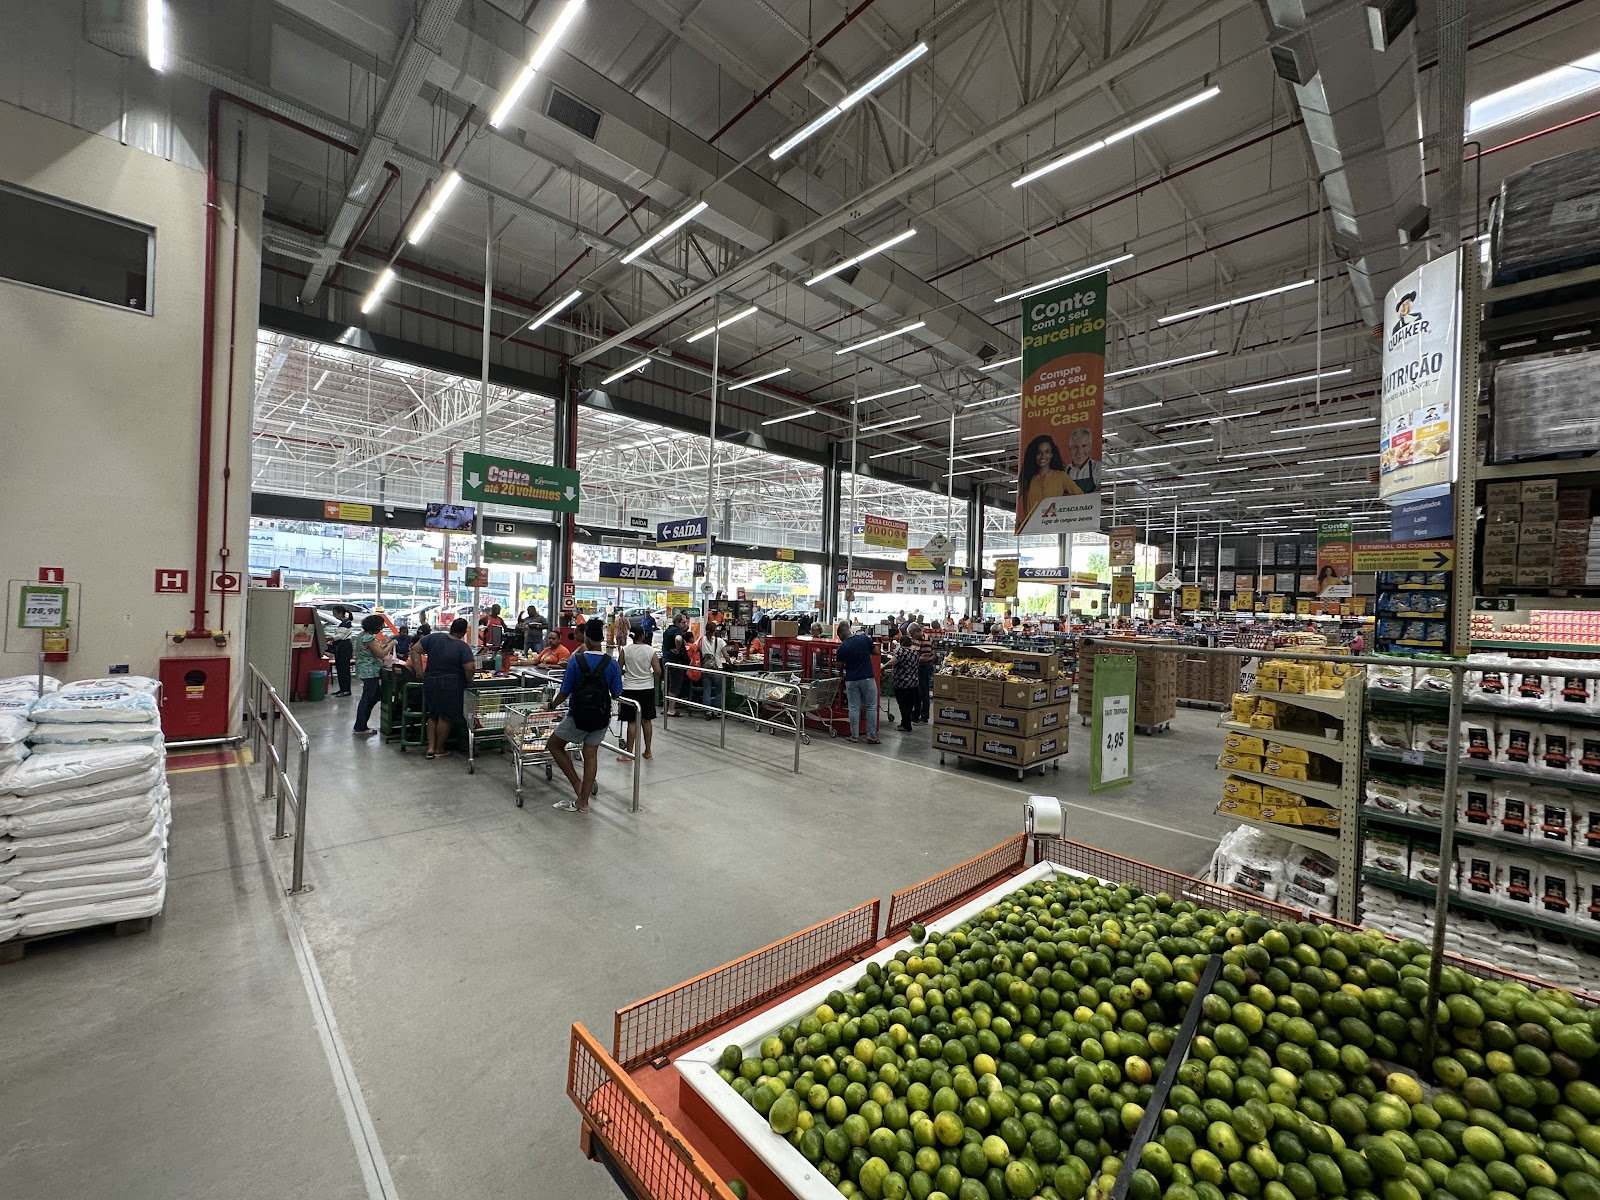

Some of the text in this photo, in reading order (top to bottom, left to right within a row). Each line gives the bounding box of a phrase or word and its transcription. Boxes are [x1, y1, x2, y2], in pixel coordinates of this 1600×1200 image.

[1030, 290, 1097, 321] Conte
[1031, 308, 1089, 331] com o seu
[1022, 317, 1106, 350] Parceirão
[1387, 320, 1430, 352] QUAKER
[1039, 365, 1082, 382] Compre
[1383, 352, 1443, 397] NUTRIÇÃO
[1033, 373, 1087, 393] para o seu
[1023, 382, 1098, 409] Negócio
[1027, 398, 1097, 418] ou para a sua
[1050, 410, 1089, 427] Casa
[486, 465, 531, 487] Caixa
[483, 483, 562, 501] até 20 volumes
[1402, 501, 1442, 514] Achocolatados
[631, 519, 648, 527] SAÍDA
[672, 520, 703, 539] SAÍDA
[867, 517, 907, 530] CAIXA EXCLUSIVO
[1041, 518, 1053, 526] Lugar
[1321, 522, 1349, 530] Conte
[619, 563, 659, 580] SAÍDA
[694, 564, 704, 574] 10
[1033, 568, 1063, 578] SAÍDA
[161, 572, 182, 588] H
[906, 577, 916, 585] VISA
[564, 586, 575, 594] H
[26, 607, 61, 617] 128,90
[1106, 731, 1125, 751] 2,95
